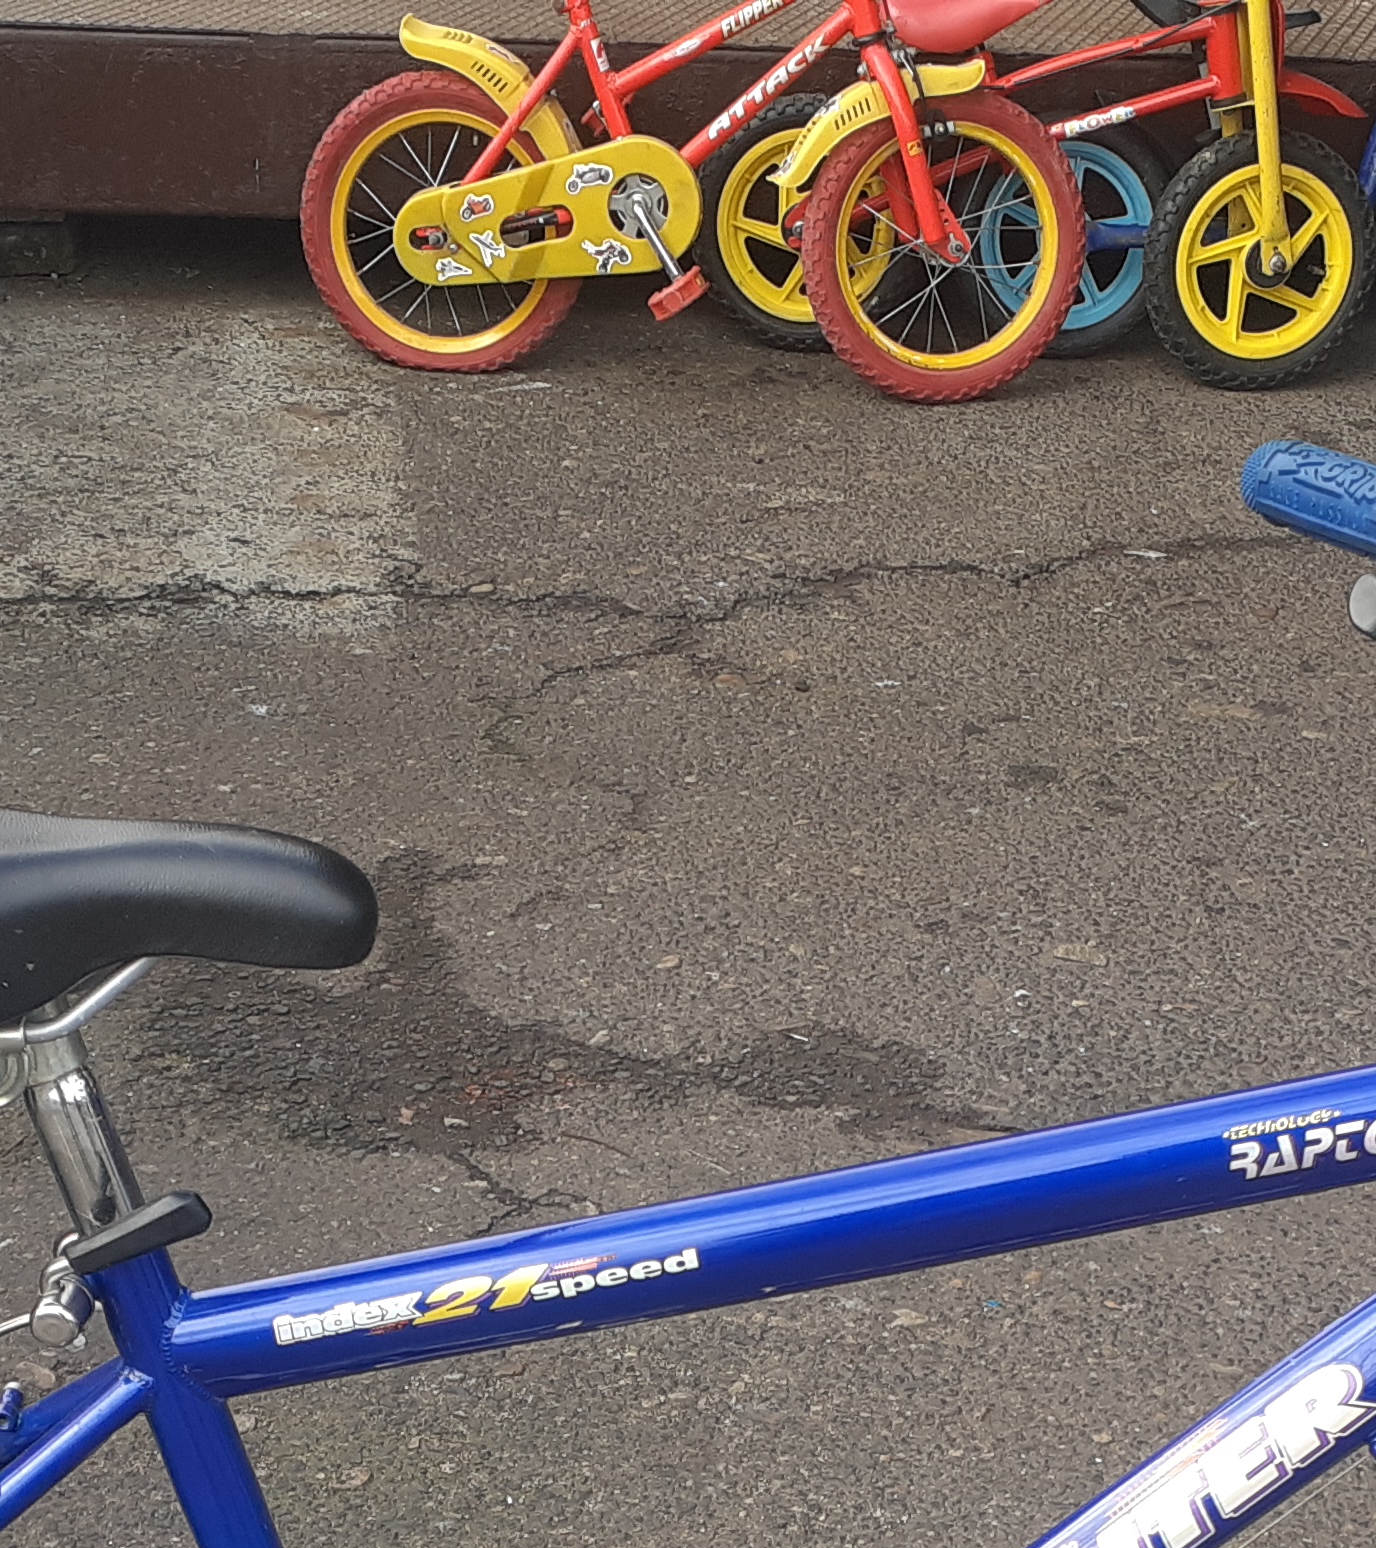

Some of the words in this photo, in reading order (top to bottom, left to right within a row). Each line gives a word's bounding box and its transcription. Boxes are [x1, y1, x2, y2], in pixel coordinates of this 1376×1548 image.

[708, 33, 829, 140] ATTACK
[1068, 107, 1136, 136] FLOWER
[273, 1291, 422, 1346] index
[415, 1264, 551, 1326] 21
[530, 1247, 700, 1302] speed
